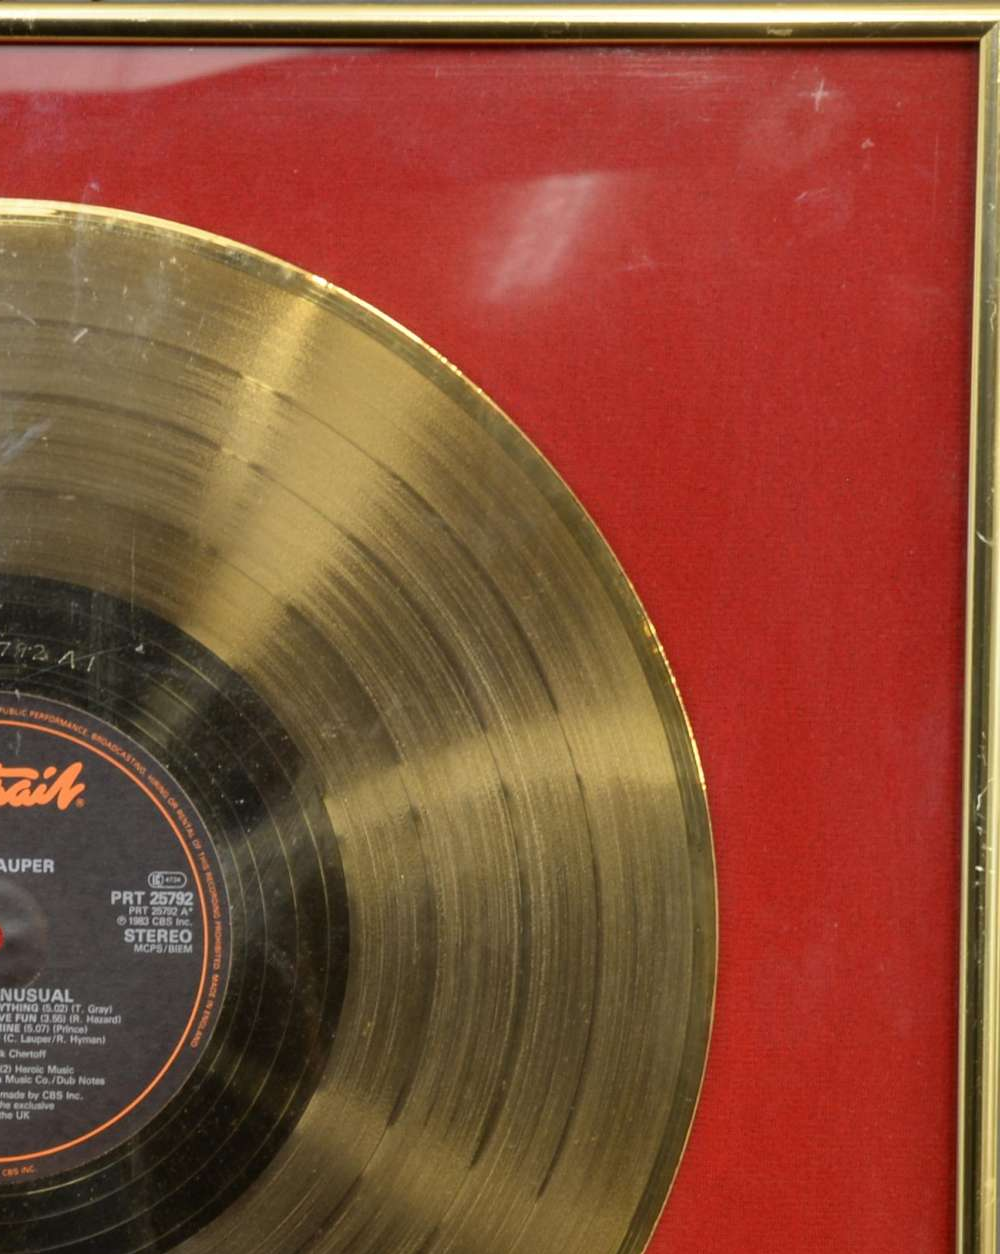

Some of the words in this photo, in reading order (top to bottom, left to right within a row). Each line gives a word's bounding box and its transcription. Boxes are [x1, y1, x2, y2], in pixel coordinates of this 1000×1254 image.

[111, 890, 146, 905] PRT
[150, 891, 194, 906] 25792
[128, 906, 149, 915] PRT
[152, 906, 178, 916] 25792
[129, 916, 150, 926] 1983
[152, 917, 173, 926] CBS
[124, 929, 193, 943] STEREO
[134, 943, 193, 953] MCPS/BIEM
[88, 1005, 112, 1016] Gray)
[15, 1014, 36, 1023] FUN
[86, 1015, 121, 1025] Hazard)
[53, 1025, 88, 1035] (Prince)
[70, 1035, 106, 1046] Hyman)
[8, 1049, 46, 1059] Chertoff
[0, 1065, 11, 1075] (2)
[15, 1065, 44, 1074] Heroic
[47, 1066, 74, 1075] Music
[5, 1075, 32, 1085] Music
[78, 1076, 105, 1086] Notes
[0, 1090, 25, 1100] made
[28, 1091, 39, 1101] by
[42, 1091, 62, 1100] CBS
[14, 1101, 55, 1111] exclusive
[16, 1111, 30, 1120] UK
